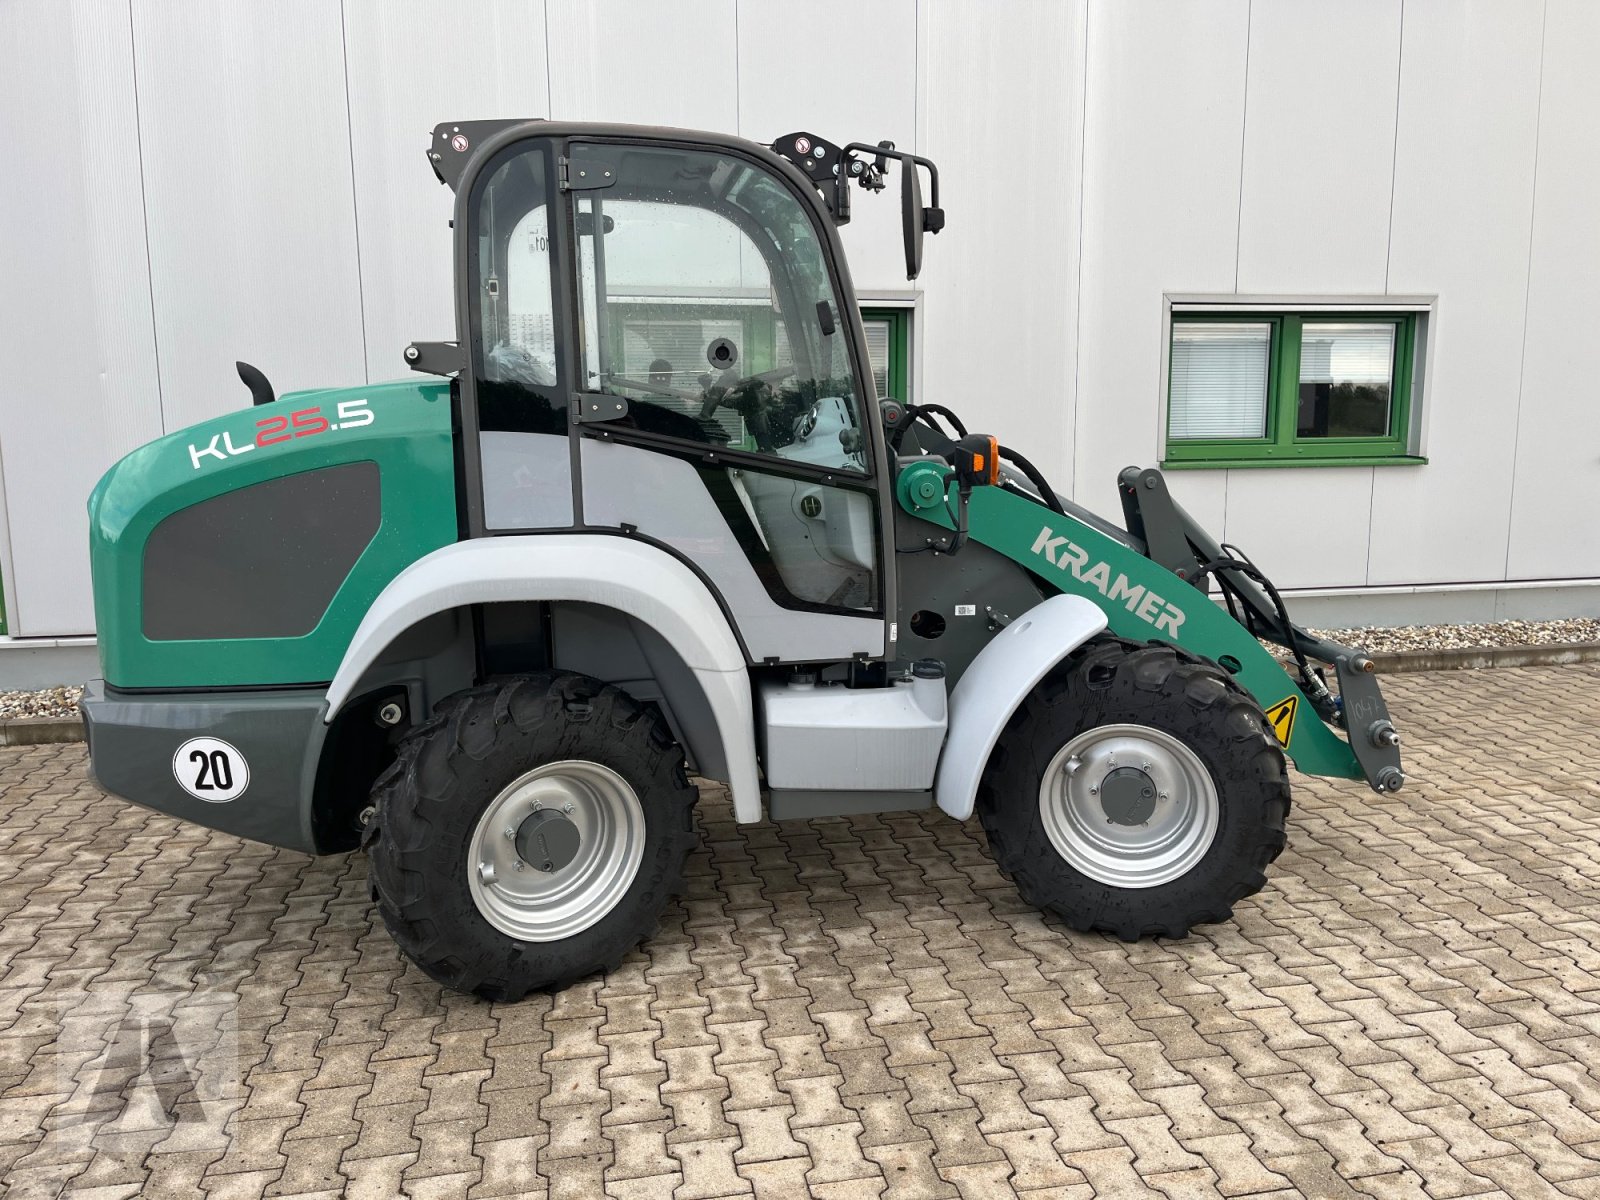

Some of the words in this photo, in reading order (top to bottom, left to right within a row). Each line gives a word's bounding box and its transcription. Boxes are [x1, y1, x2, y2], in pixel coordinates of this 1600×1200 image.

[189, 399, 375, 469] KL25.5
[1031, 526, 1186, 640] KRAMER
[190, 750, 233, 790] 20
